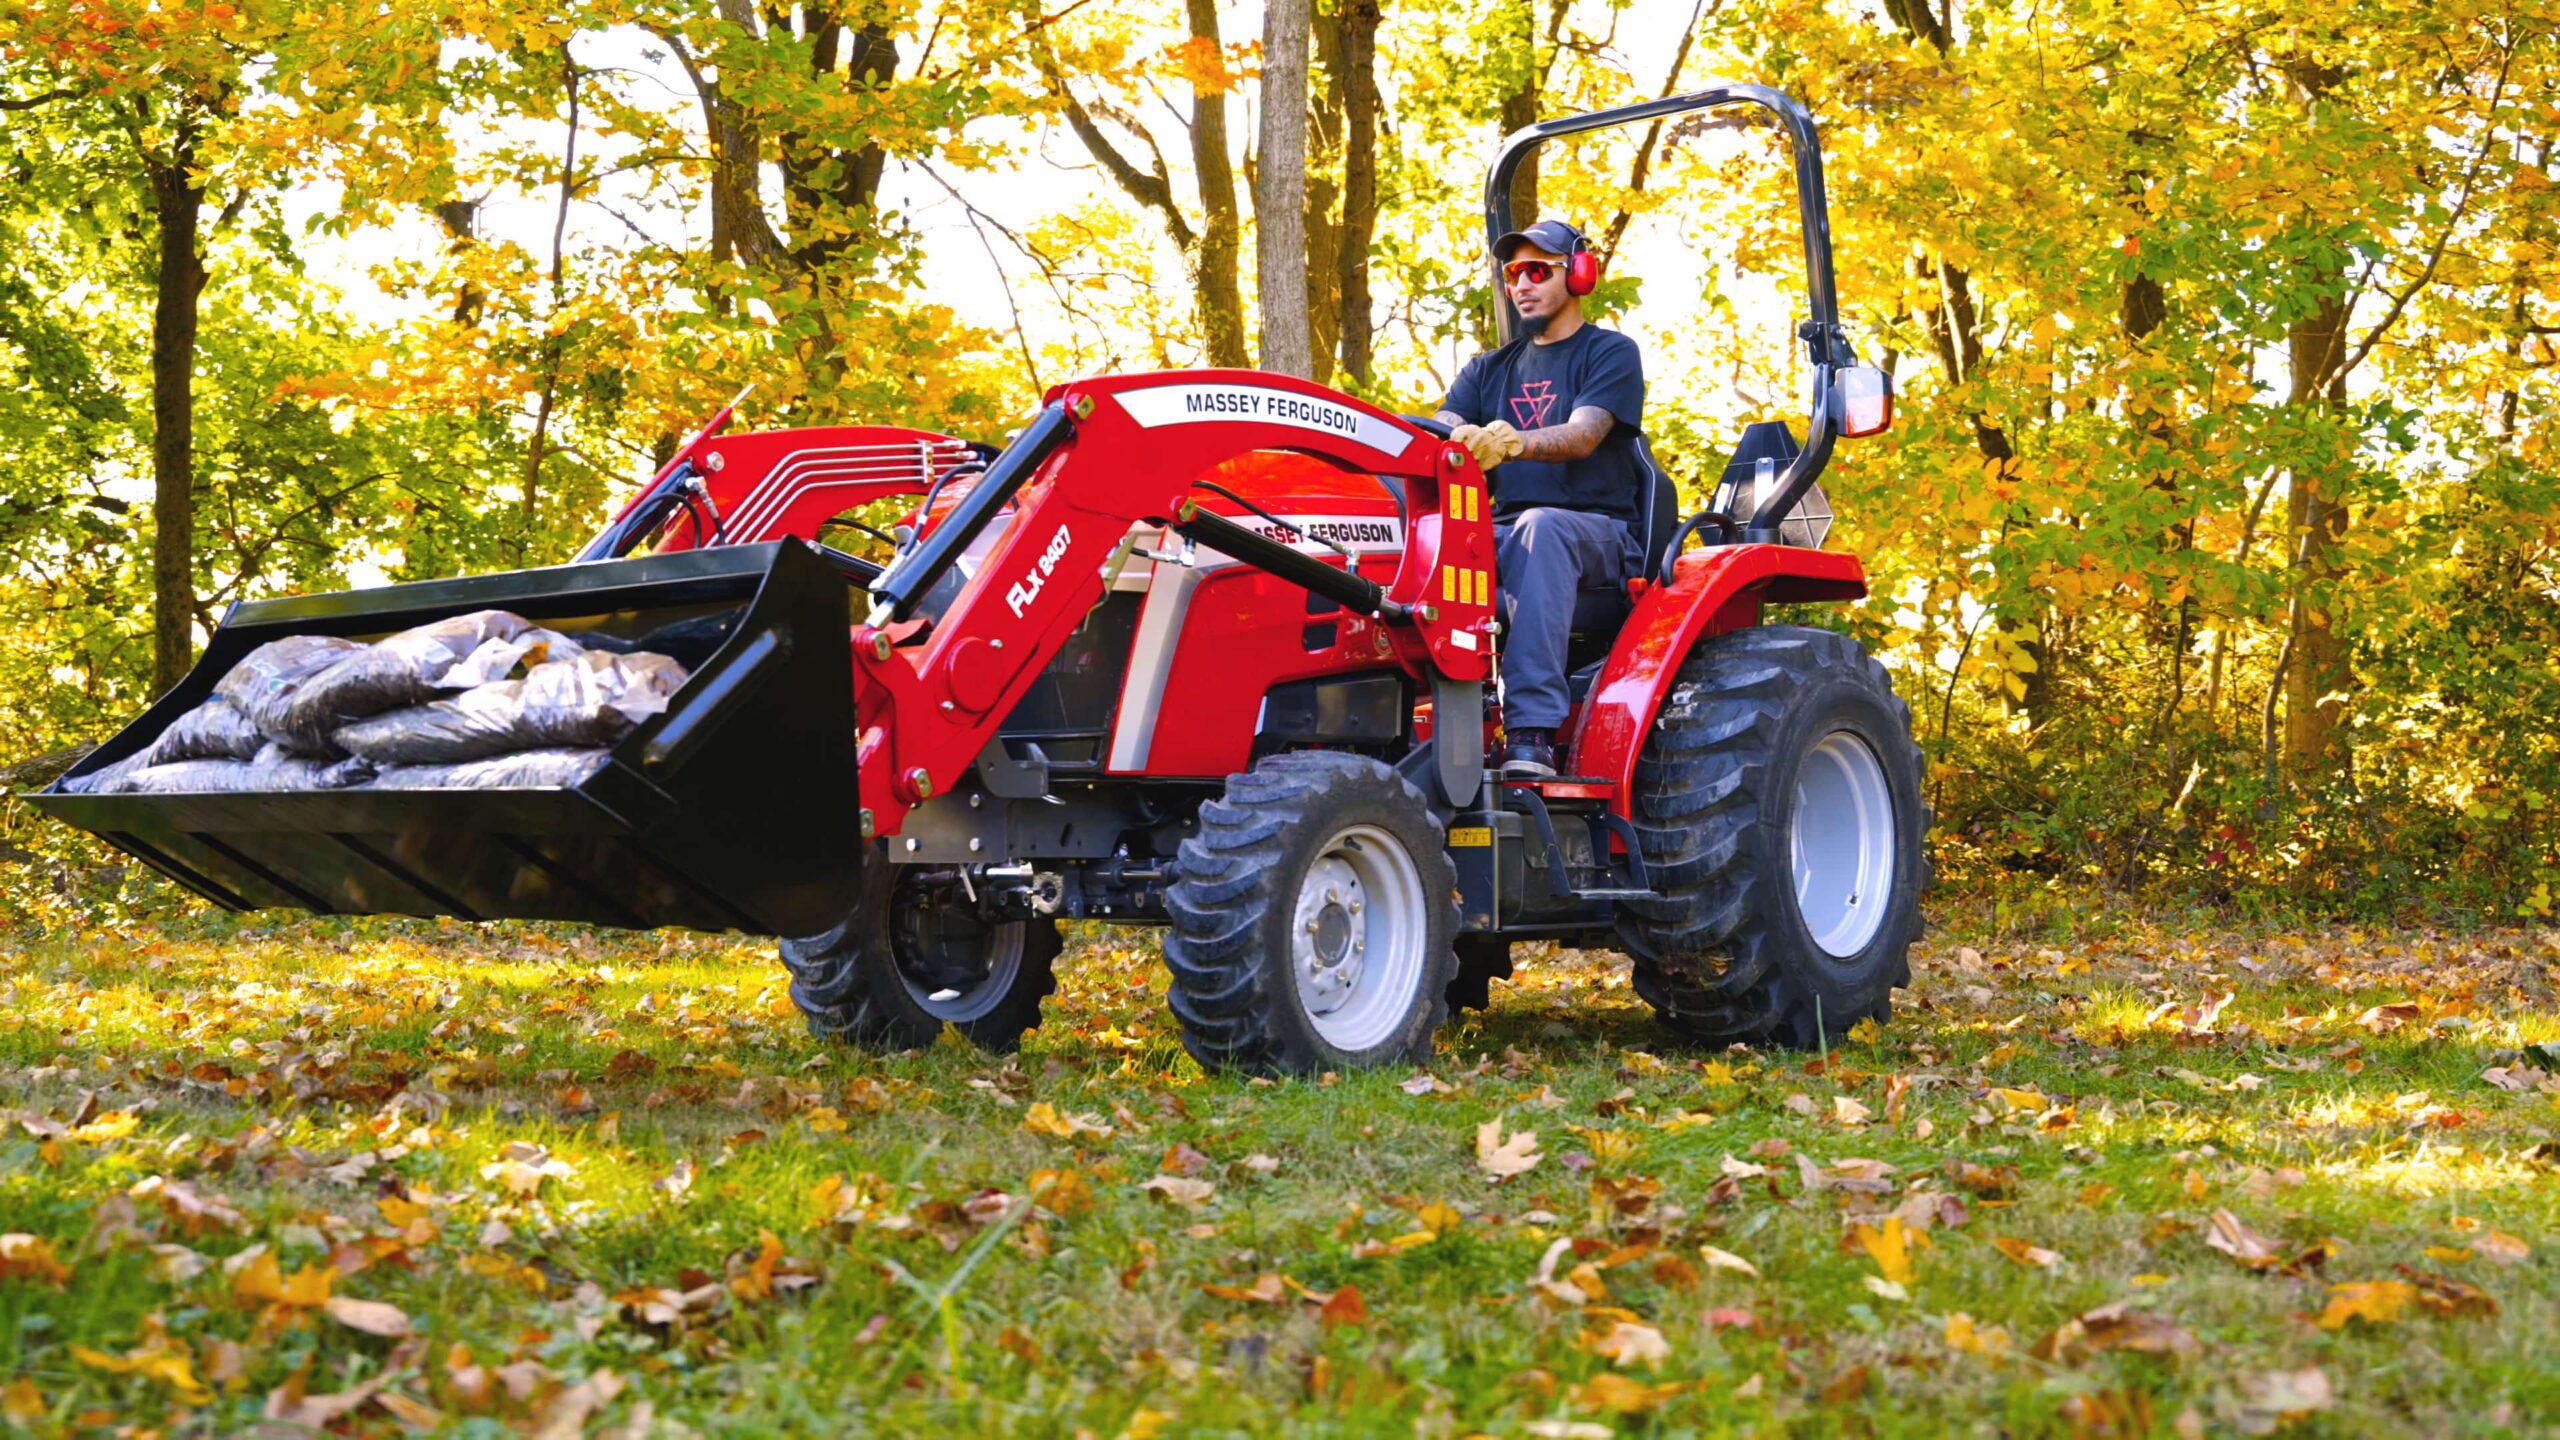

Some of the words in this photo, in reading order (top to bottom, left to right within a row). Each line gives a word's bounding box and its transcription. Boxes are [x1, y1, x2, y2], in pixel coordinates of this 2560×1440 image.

[1186, 393, 1260, 413] MASSEY
[1267, 397, 1357, 434] FERGUSON
[1038, 523, 1071, 577] 2407
[1254, 524, 1304, 544] SSE
[1309, 523, 1394, 543] FERGUSON
